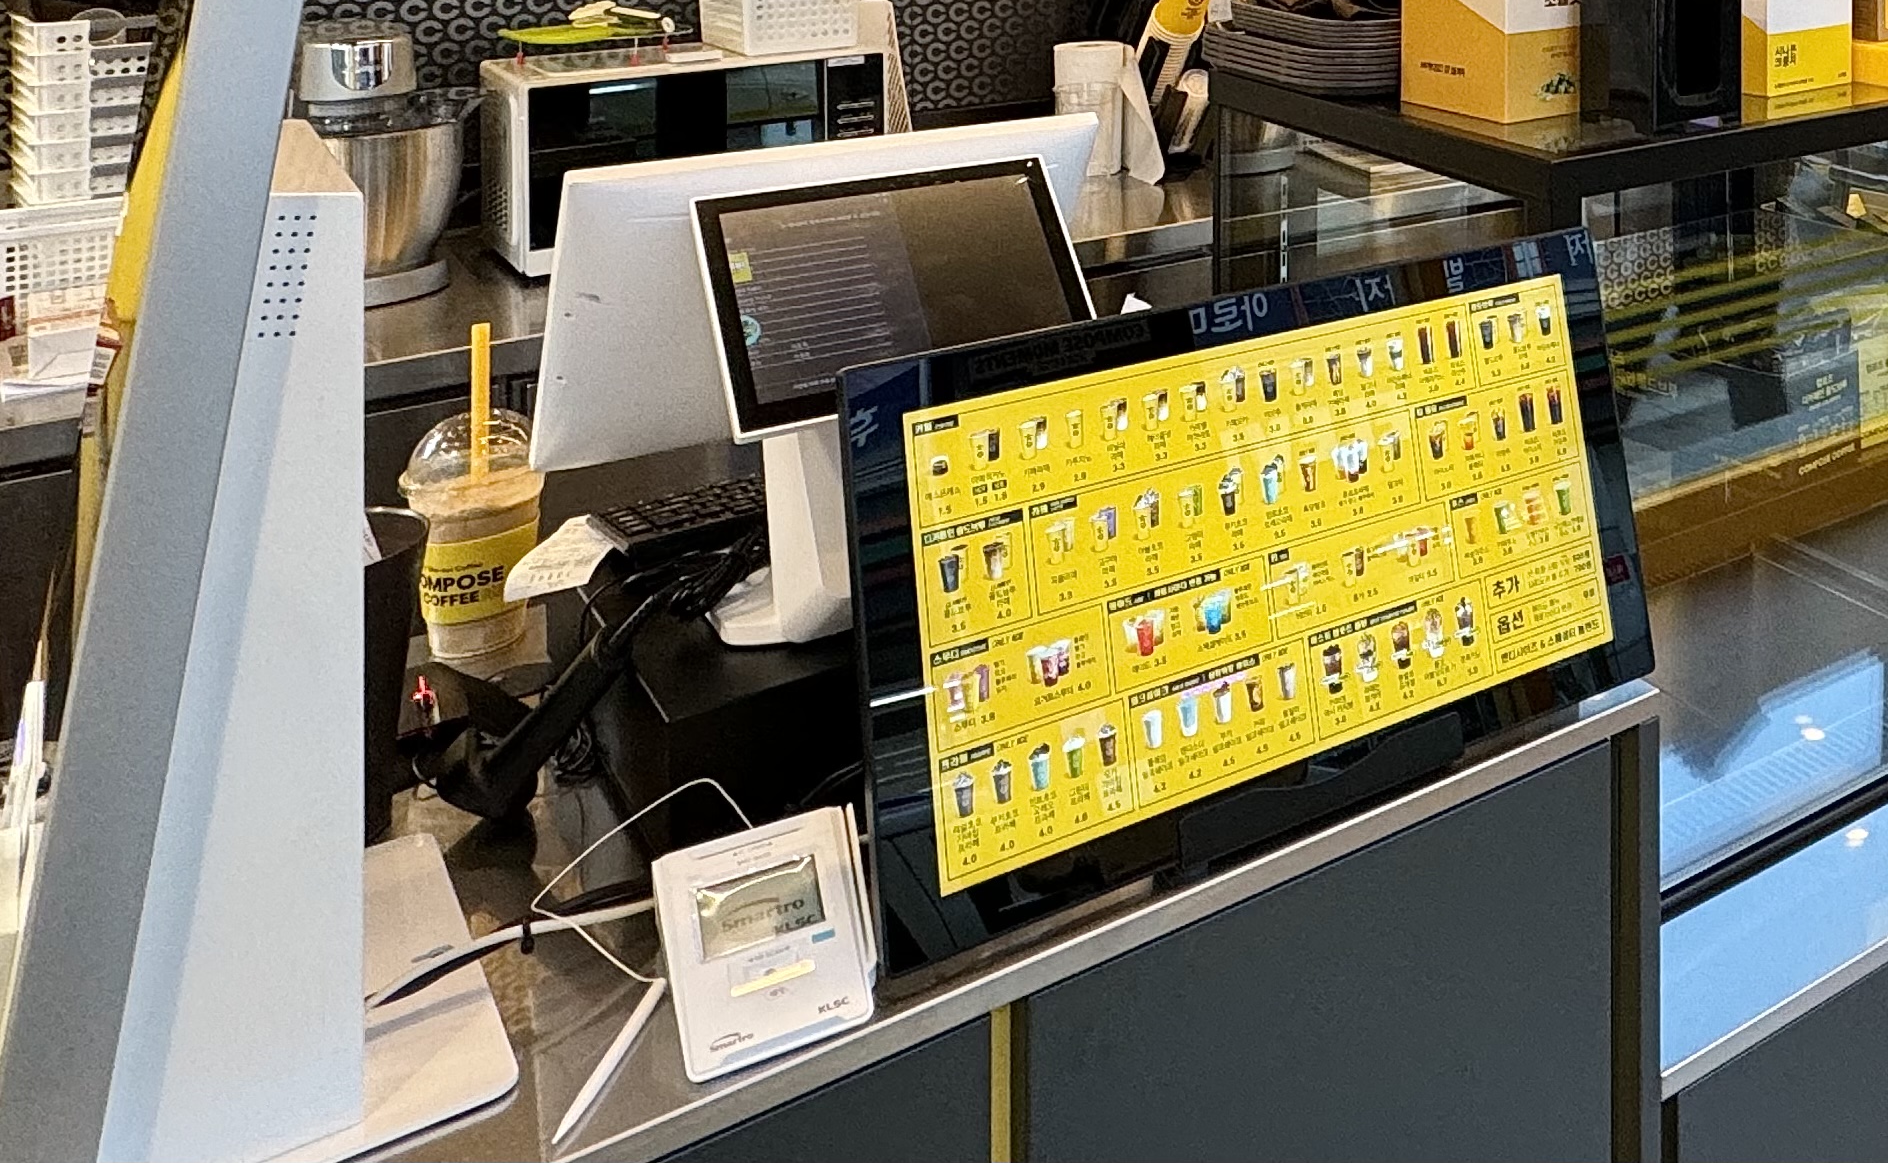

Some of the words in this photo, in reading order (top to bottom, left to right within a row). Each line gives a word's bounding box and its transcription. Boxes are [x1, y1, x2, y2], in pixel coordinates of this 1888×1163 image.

[421, 565, 504, 593] OMPOSE
[1493, 575, 1520, 599] 추가
[424, 590, 479, 607] COFFEE
[1497, 609, 1524, 635] 옵션
[933, 649, 959, 665] 스무디
[722, 897, 805, 933] Smartro
[774, 913, 816, 934] KLSC
[818, 996, 850, 1014] KLSC
[709, 1032, 754, 1052] Smartro
